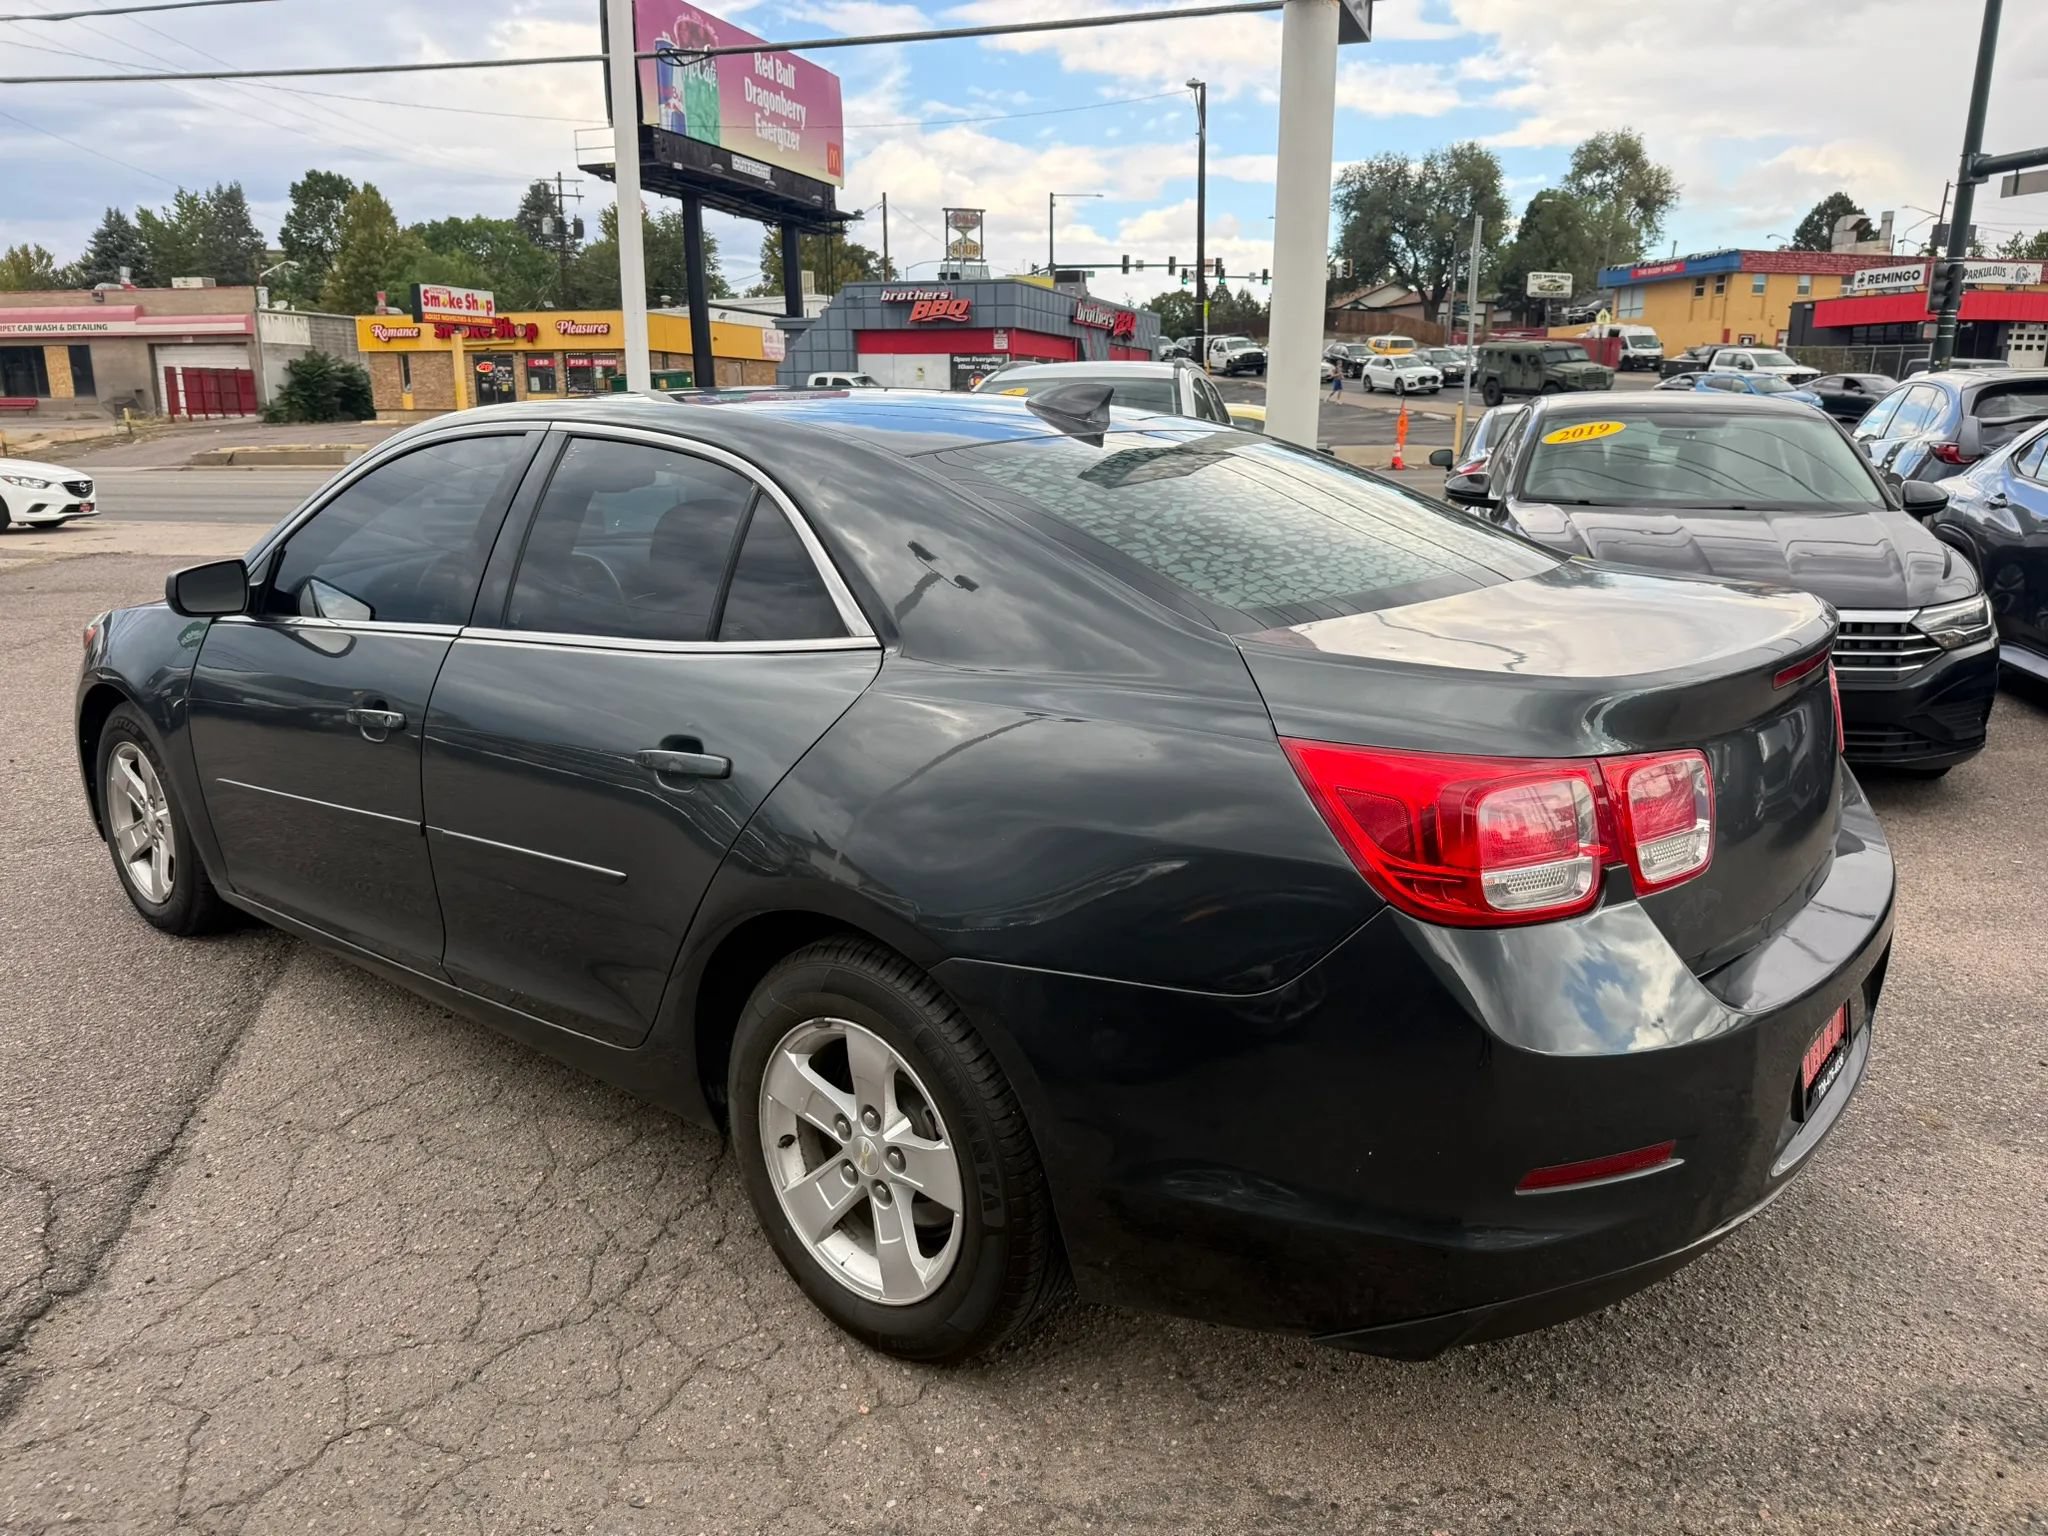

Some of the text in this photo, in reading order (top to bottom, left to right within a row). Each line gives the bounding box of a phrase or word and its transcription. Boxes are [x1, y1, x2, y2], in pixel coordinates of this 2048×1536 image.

[754, 52, 795, 89] Red Bull
[744, 76, 806, 130] Dragonberry
[755, 112, 800, 152] Energizer
[1867, 270, 1921, 285] REMINGO
[881, 289, 949, 301] brothers
[909, 300, 970, 322] BBQ
[1076, 302, 1115, 328] brothers
[35, 324, 57, 332] WASH
[67, 323, 108, 331] DETAILING
[371, 324, 420, 342] Romance
[556, 320, 609, 335] Pleasures
[1559, 423, 1610, 441] 2019
